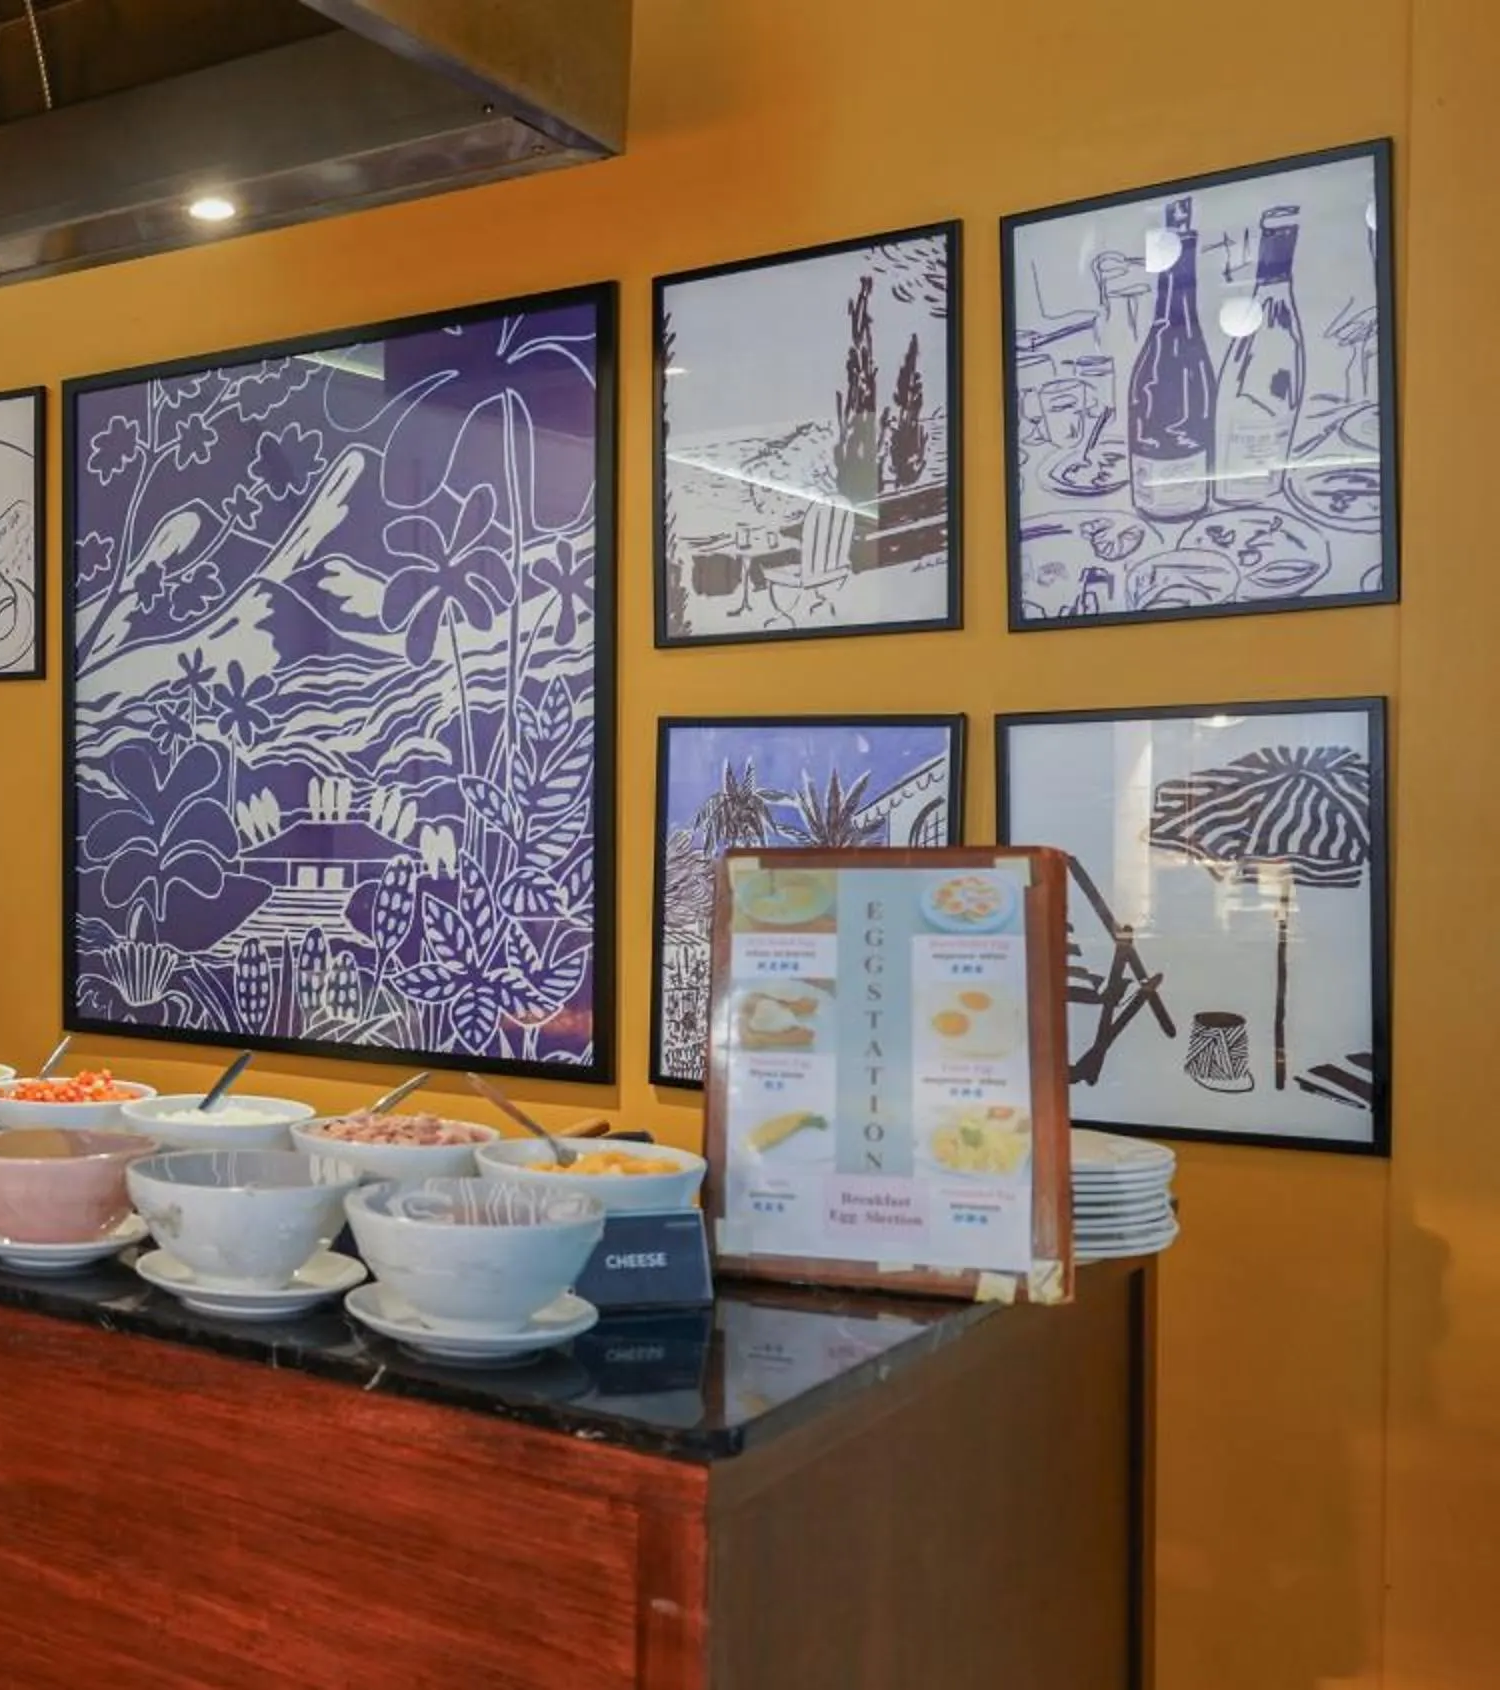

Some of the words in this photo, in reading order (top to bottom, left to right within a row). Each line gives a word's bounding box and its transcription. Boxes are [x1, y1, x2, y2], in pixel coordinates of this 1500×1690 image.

[841, 1192, 911, 1207] Breakfast
[829, 1208, 858, 1225] Egg
[605, 1252, 668, 1269] CHEESE
